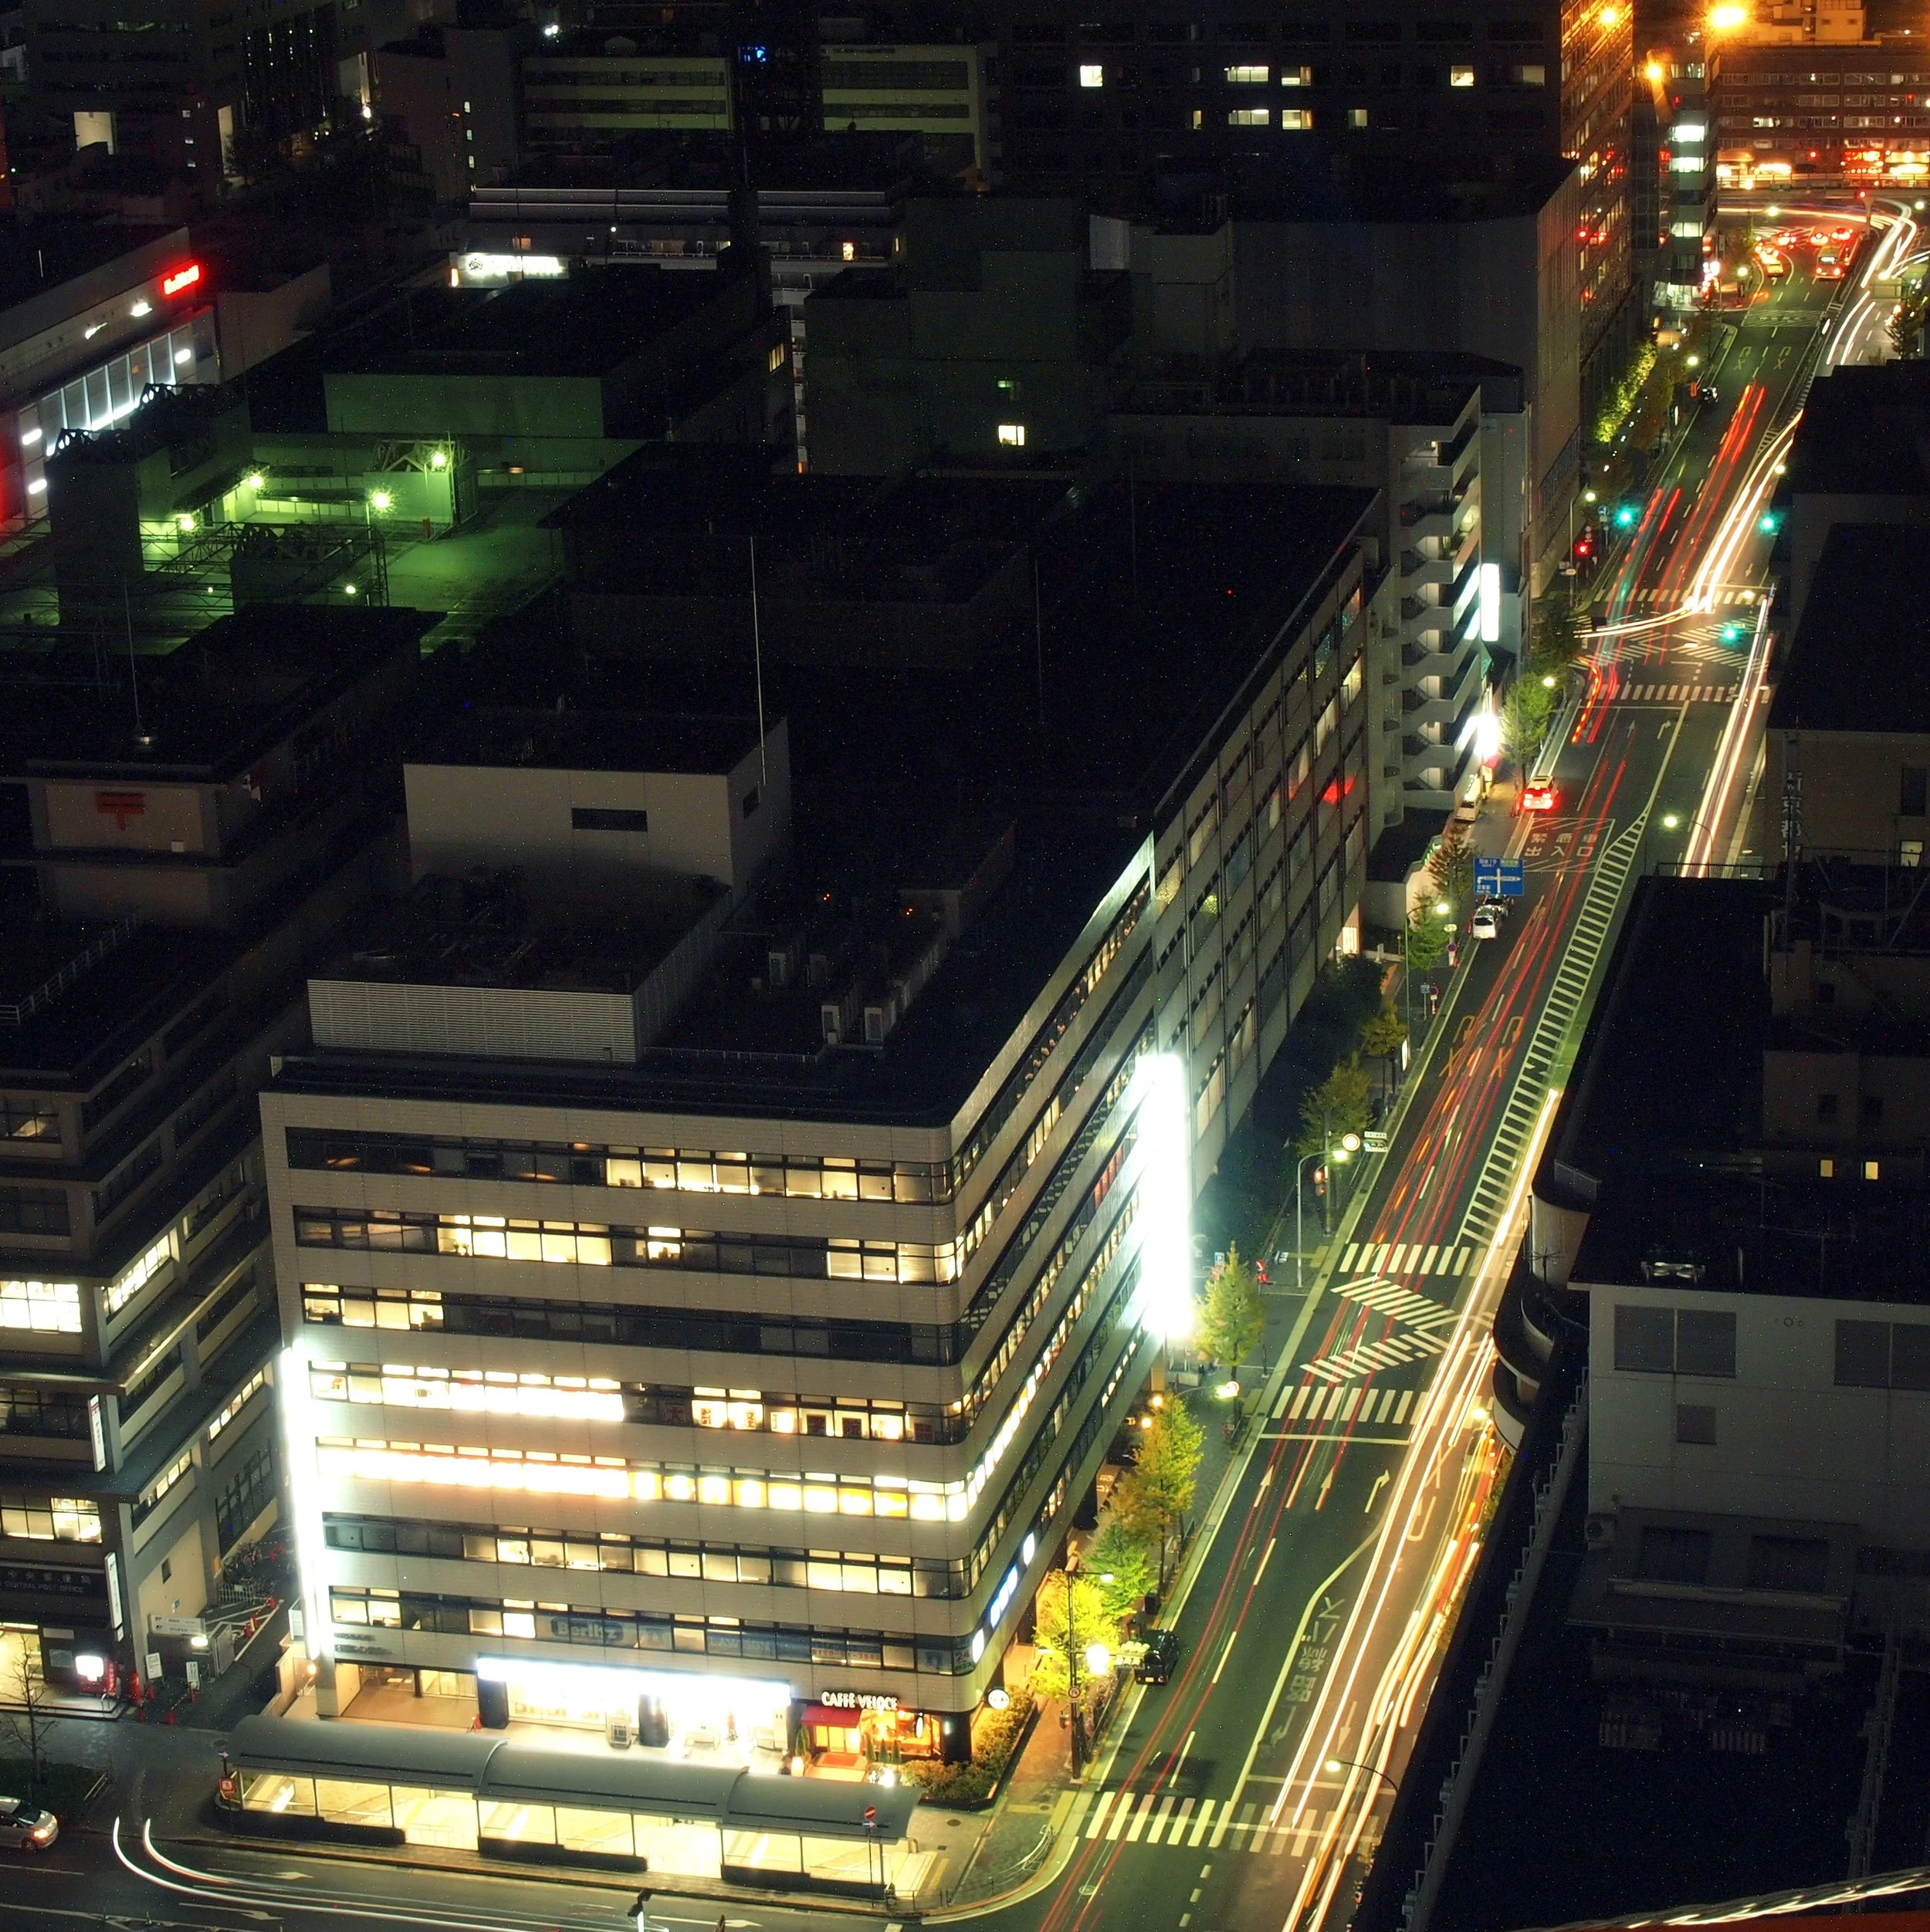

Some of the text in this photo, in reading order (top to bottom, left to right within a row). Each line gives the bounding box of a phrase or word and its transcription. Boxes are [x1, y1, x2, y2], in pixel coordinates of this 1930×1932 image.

[1525, 846, 1594, 857] 出入口
[557, 1621, 618, 1641] Berlitz
[857, 1694, 898, 1711] VELOCE
